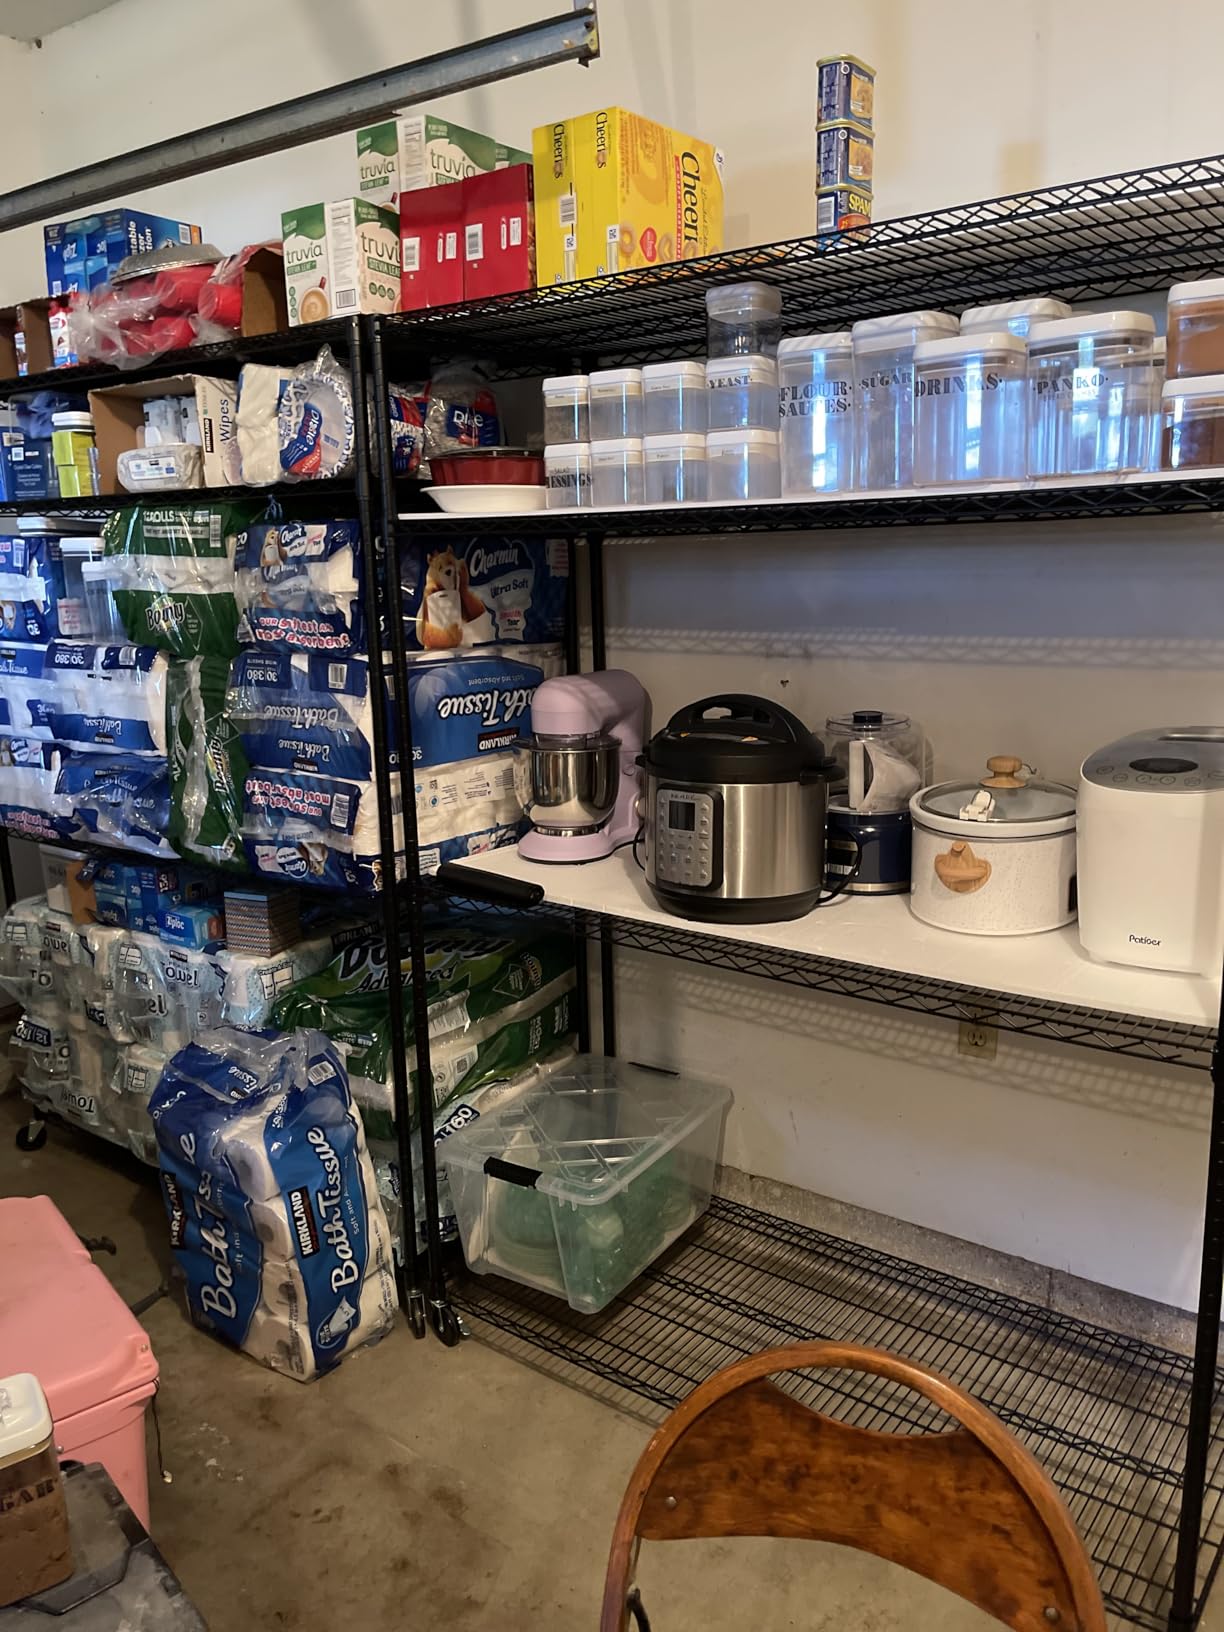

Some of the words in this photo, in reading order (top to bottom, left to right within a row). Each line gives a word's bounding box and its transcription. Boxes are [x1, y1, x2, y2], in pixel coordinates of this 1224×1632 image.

[849, 193, 872, 217] SPAM
[709, 375, 751, 390] YEAST
[780, 381, 848, 401] FLOUR
[861, 372, 913, 390] SUGAR
[1037, 373, 1105, 394] PANKO
[219, 399, 234, 442] Wipes
[453, 410, 484, 427] Die
[469, 547, 519, 578] Charmin
[512, 577, 529, 590] Soft
[145, 602, 185, 630] Bounty
[266, 671, 278, 682] 30
[263, 704, 303, 729] Tissue
[437, 689, 501, 727] Tissue
[304, 742, 330, 762] Bath
[166, 913, 185, 931] Ziploc
[162, 962, 200, 988] owel
[345, 961, 458, 994] Adced
[307, 1126, 341, 1222] Tissue
[347, 1199, 355, 1216] and
[290, 1190, 314, 1255] KIRKLAND
[352, 1218, 360, 1236] Soft
[323, 1215, 360, 1294] Bath
[200, 1224, 238, 1320] Bath
